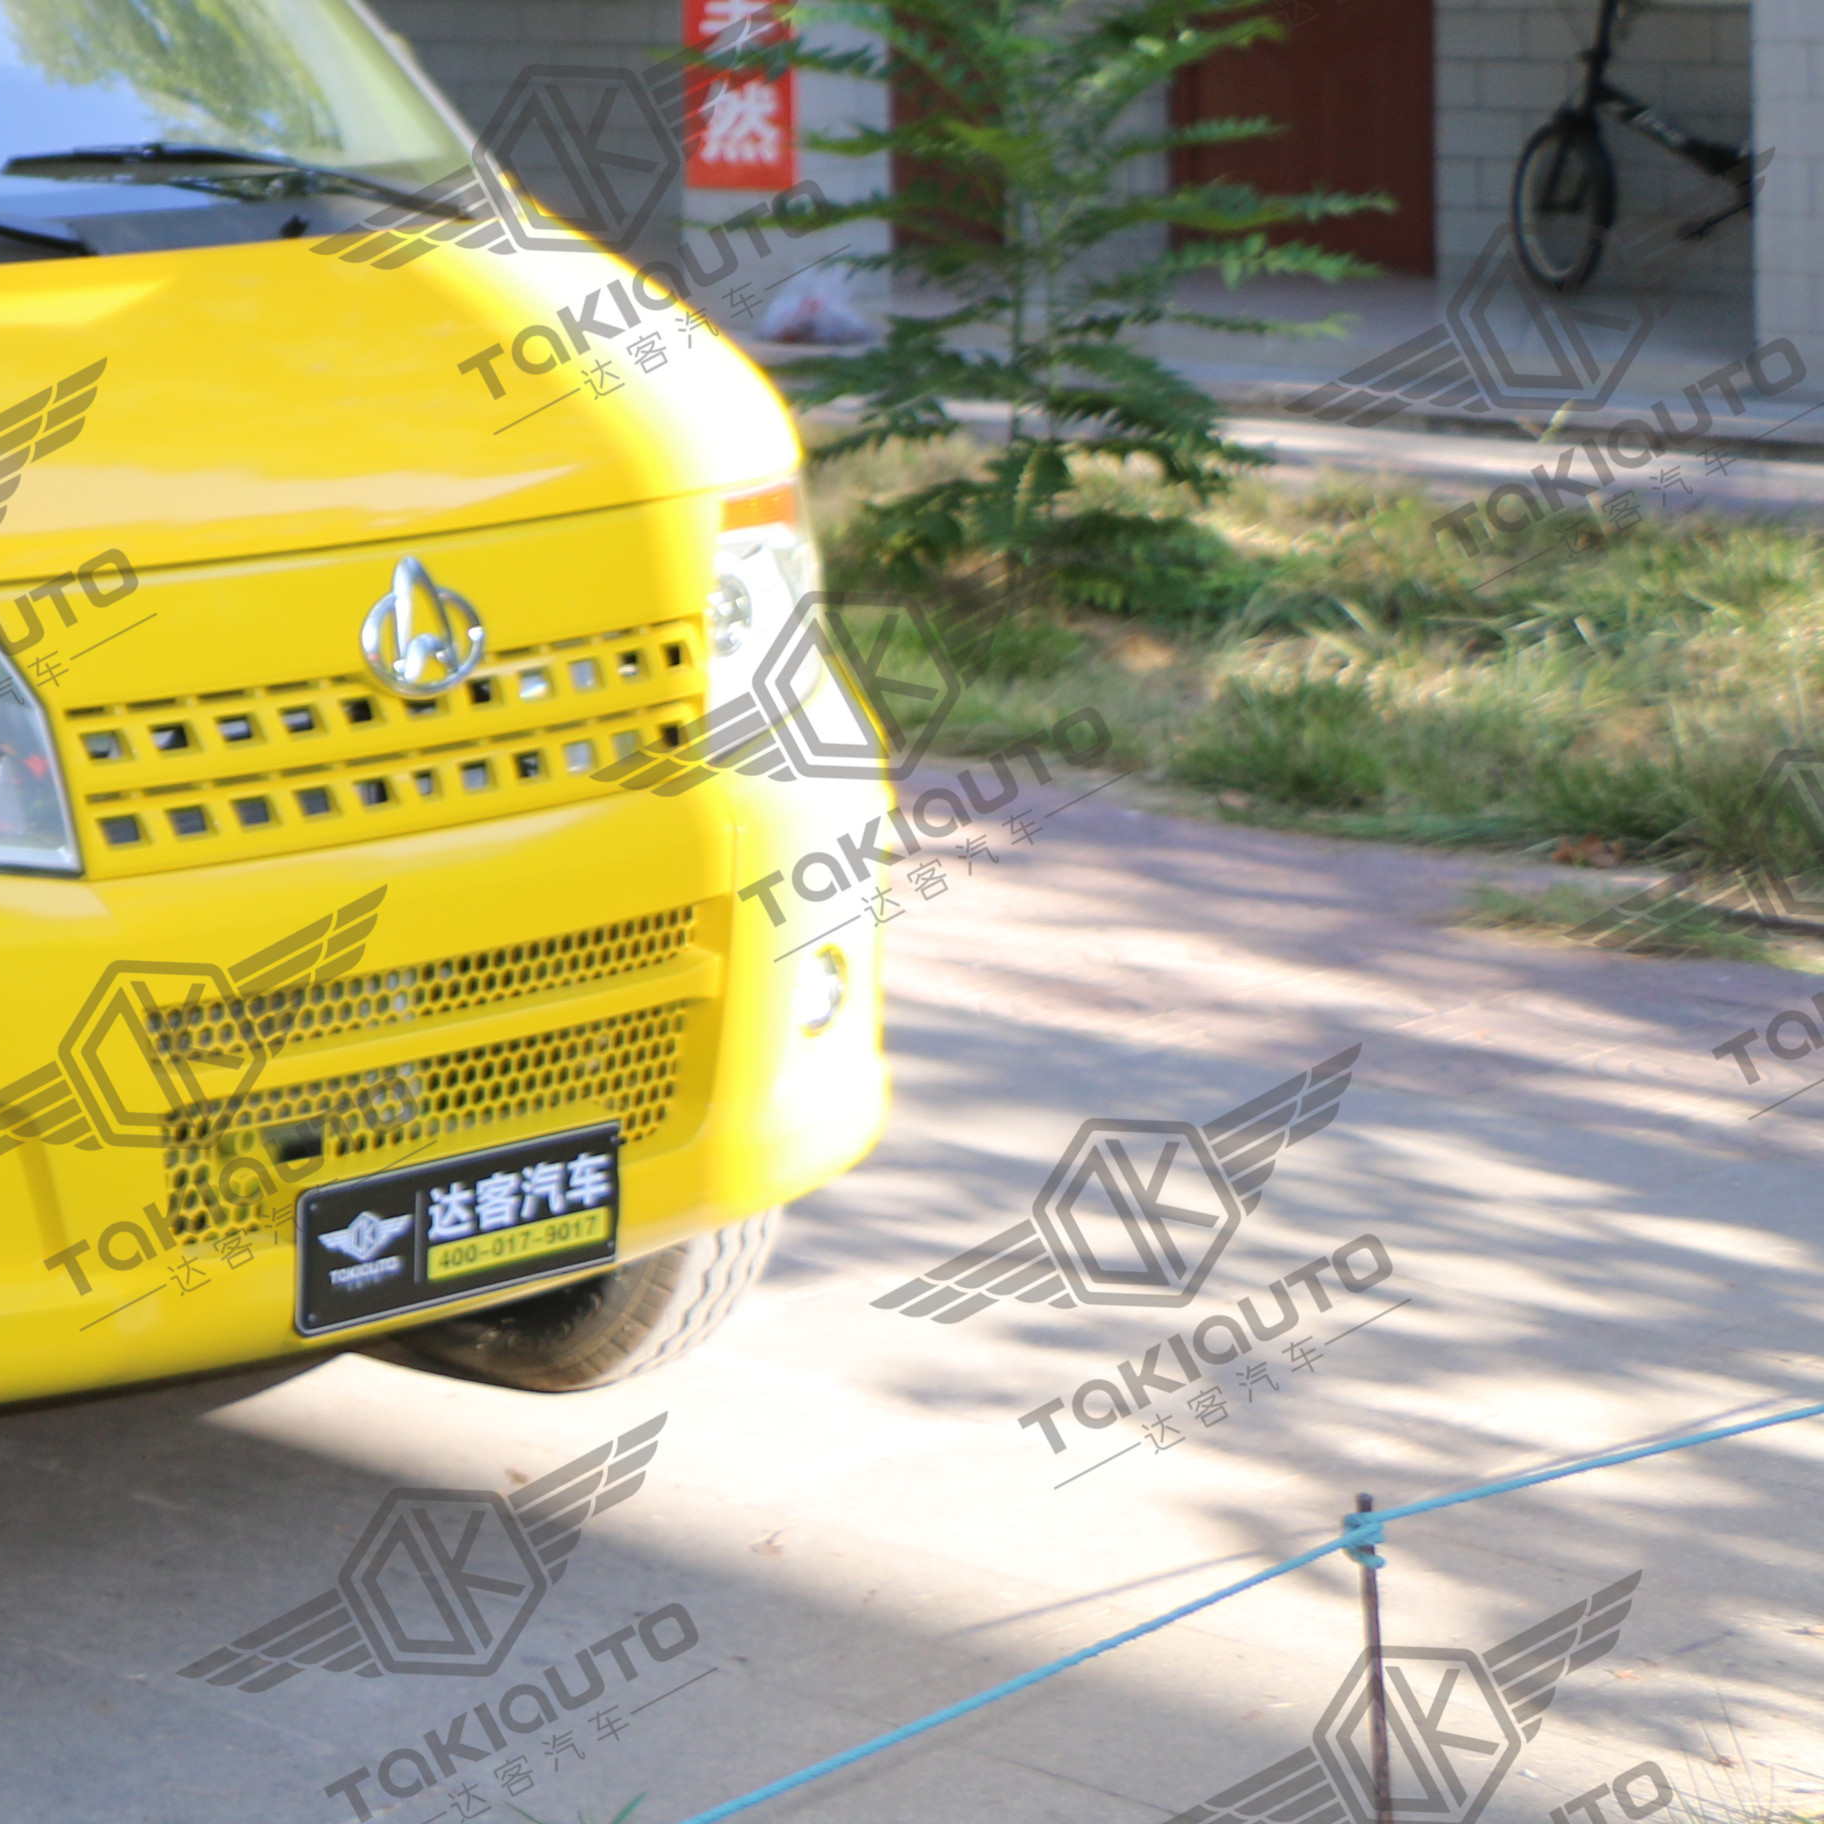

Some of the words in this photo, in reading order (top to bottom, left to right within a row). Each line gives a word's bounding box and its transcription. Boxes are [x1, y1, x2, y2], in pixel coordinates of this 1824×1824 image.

[427, 1151, 614, 1243] 达客汽车
[438, 1214, 599, 1270] 400-017-9017
